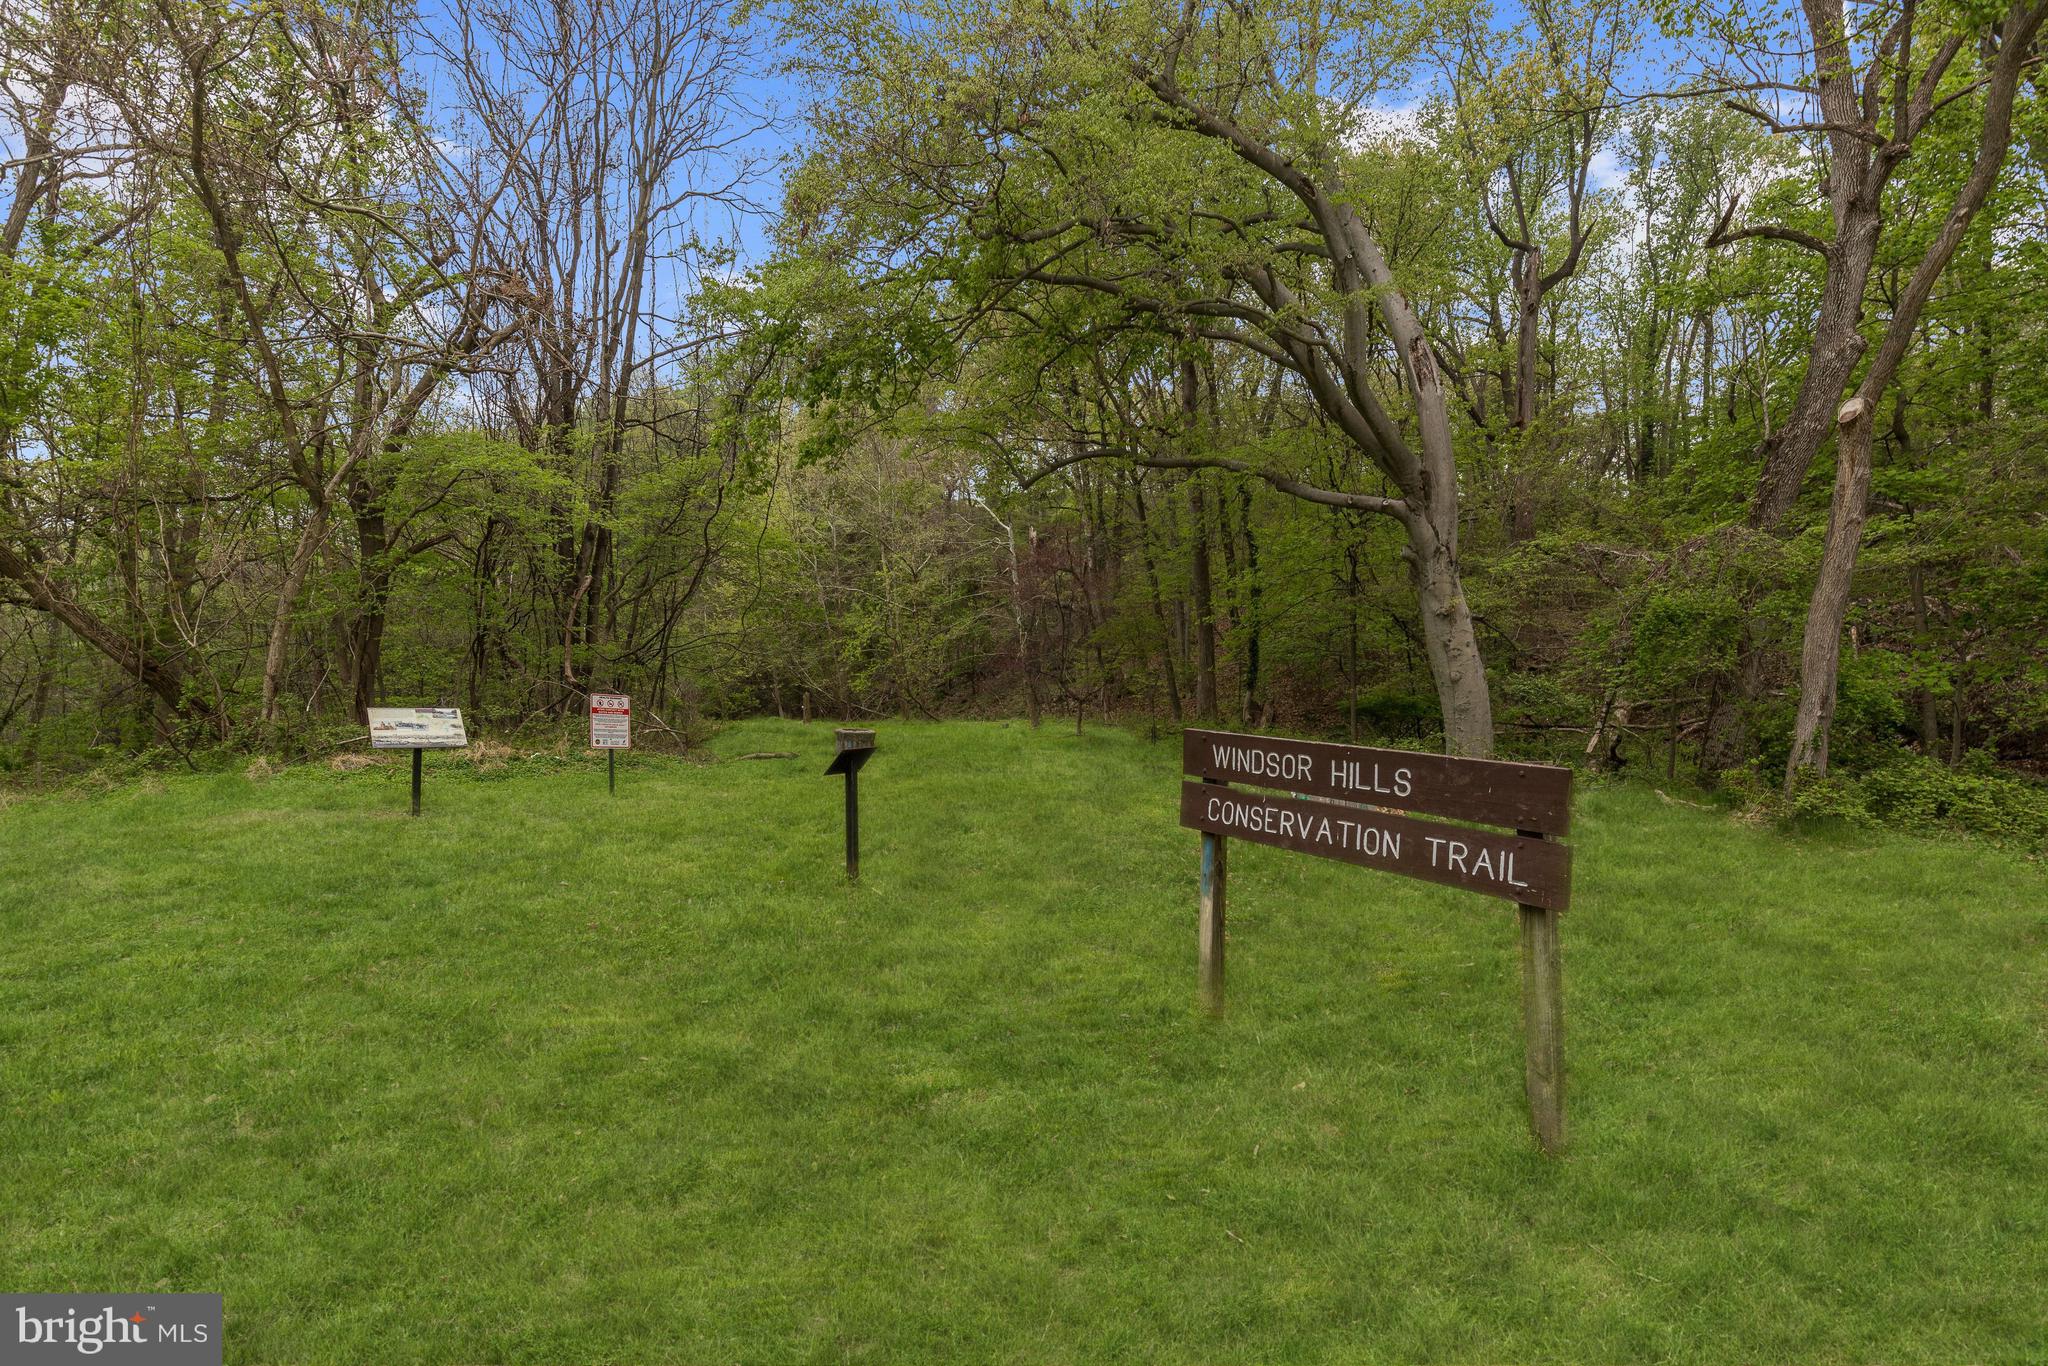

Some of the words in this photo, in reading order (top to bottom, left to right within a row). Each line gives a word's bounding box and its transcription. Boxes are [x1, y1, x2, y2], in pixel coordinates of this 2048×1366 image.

[1212, 744, 1312, 782] WINDSOR
[1331, 760, 1412, 797] HILLS
[1207, 797, 1400, 859] CONSERVATION
[1425, 837, 1528, 887] TRAIL
